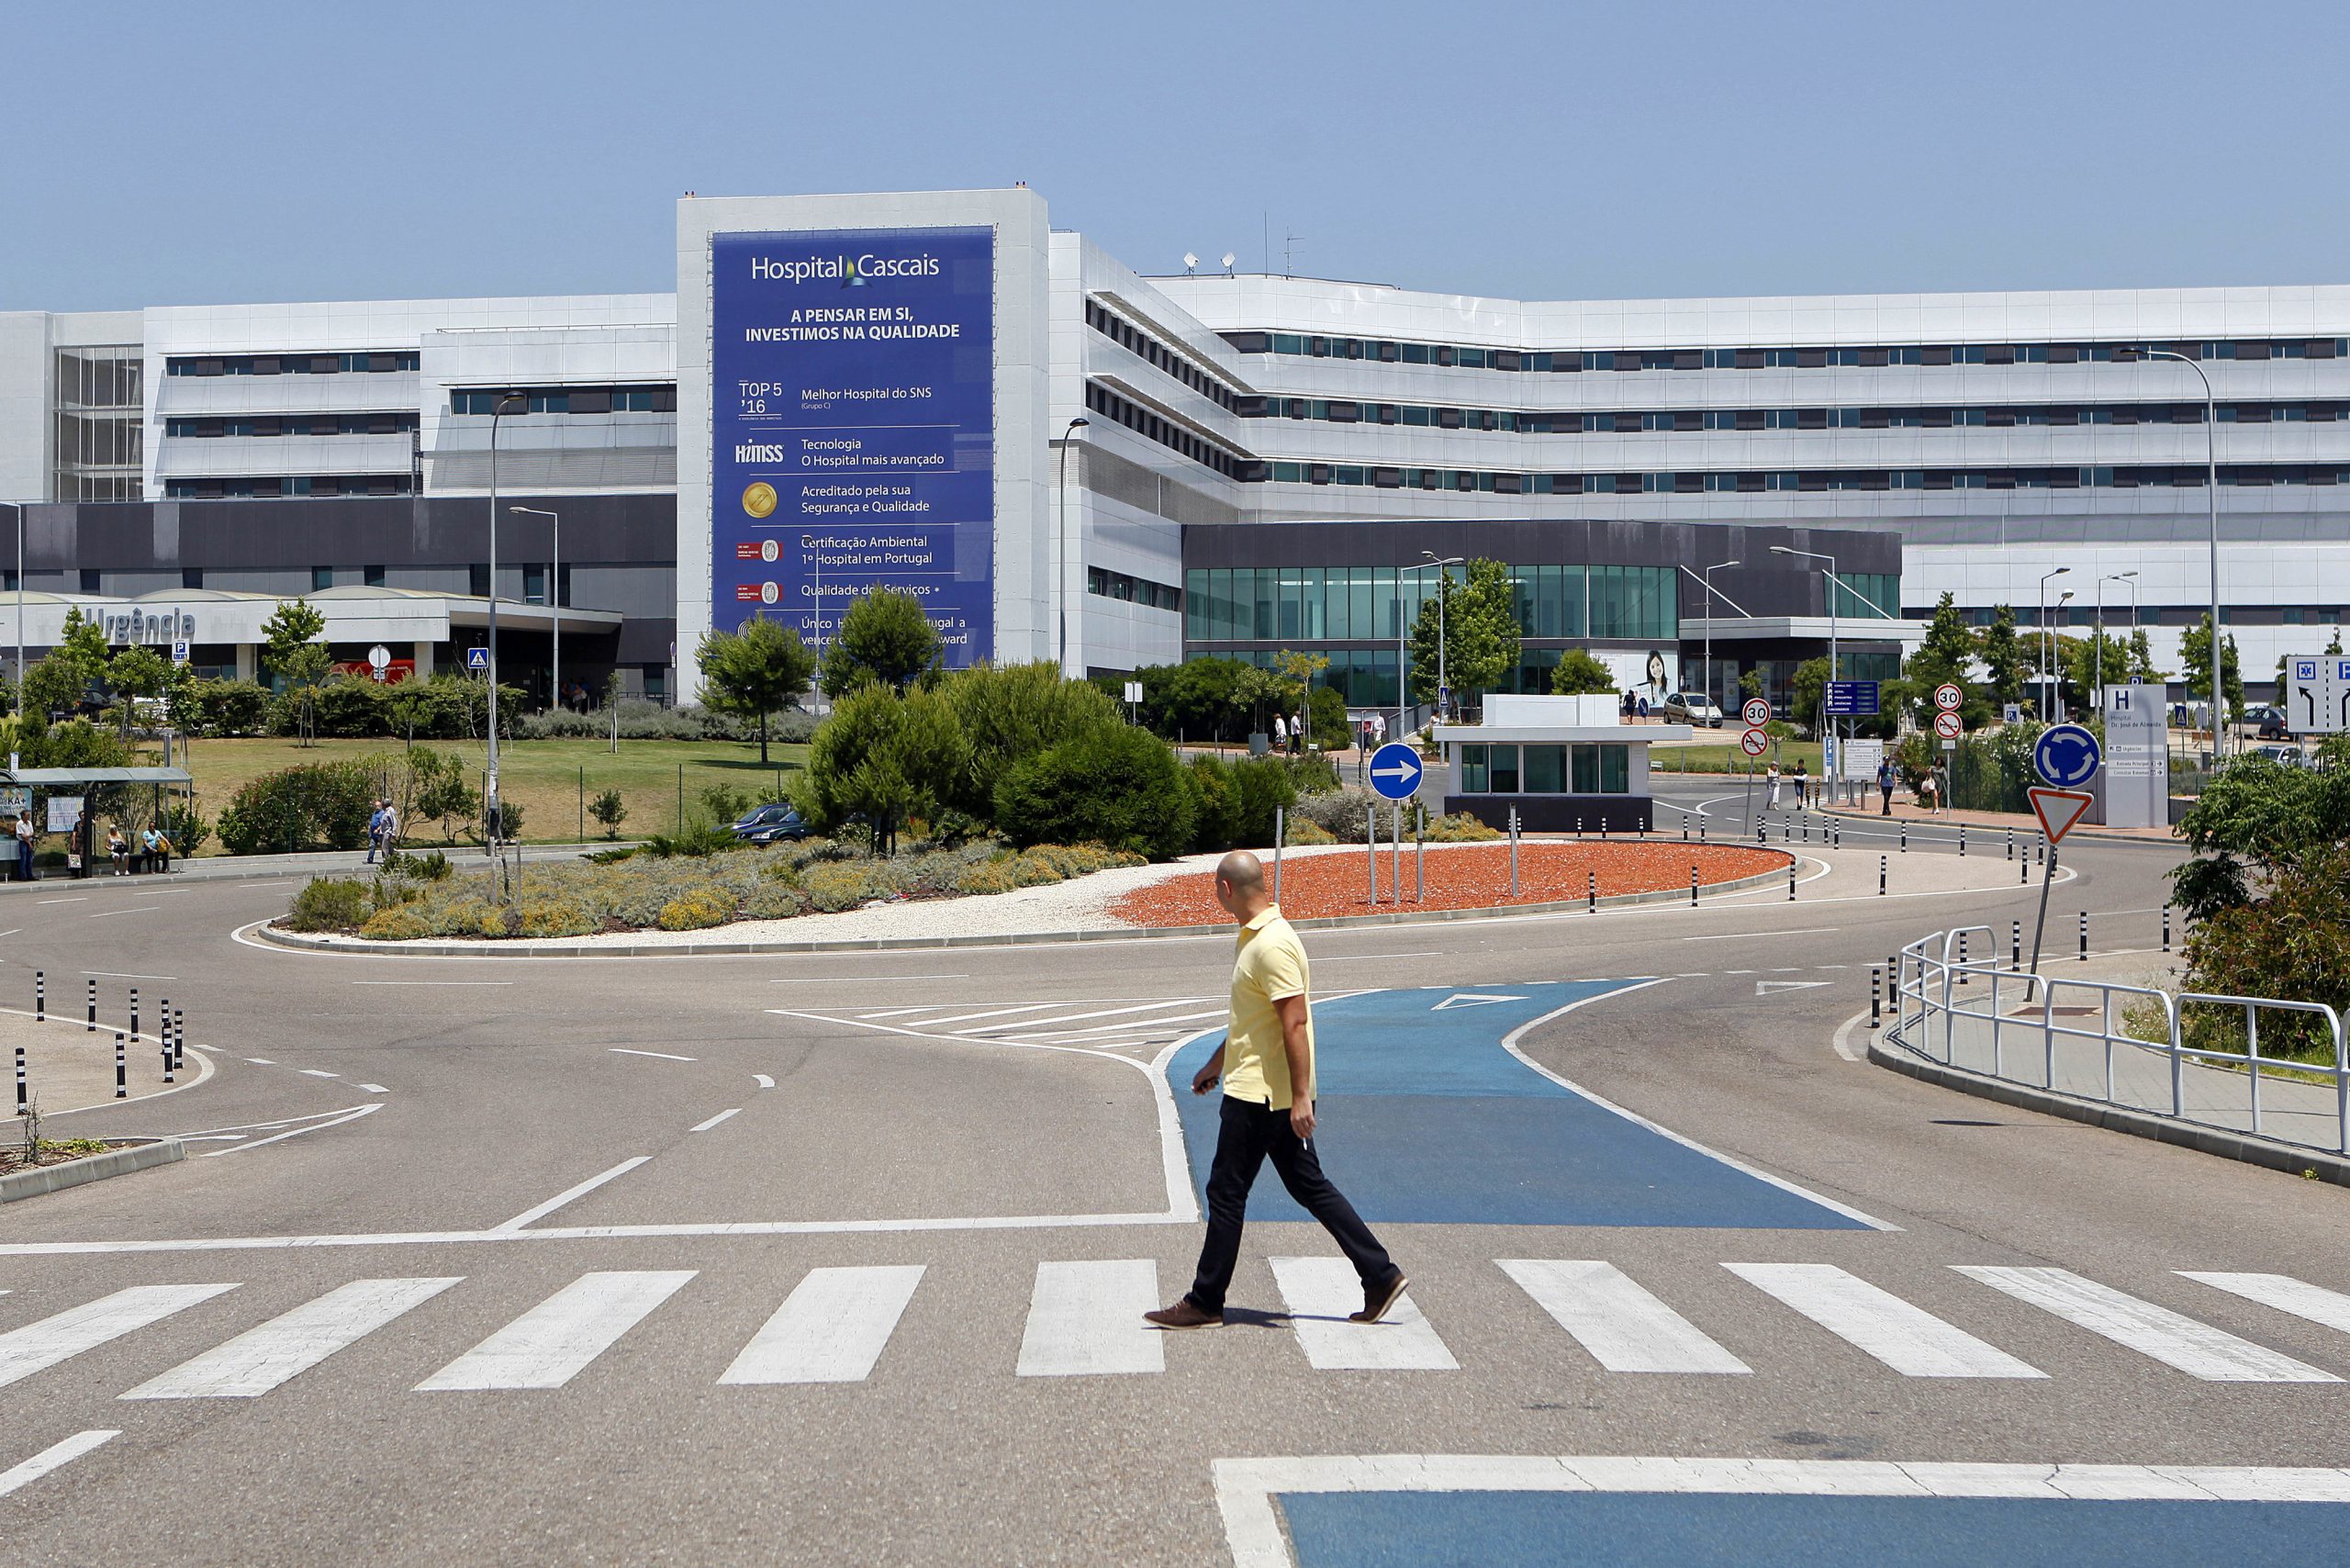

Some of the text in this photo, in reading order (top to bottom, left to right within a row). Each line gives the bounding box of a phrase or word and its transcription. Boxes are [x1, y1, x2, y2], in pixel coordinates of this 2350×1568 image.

[752, 253, 940, 285] Hospital Cascais
[790, 308, 914, 323] A PENSAR EM SI,
[745, 324, 960, 342] INVESTIMOS NA QUALIDADE
[738, 382, 782, 398] TOP 5
[801, 386, 932, 401] Melhor Hospital do SNS
[801, 402, 822, 410] (Grupo
[801, 438, 862, 452] Tecnologia
[801, 453, 945, 467] O Hospital mais avançado
[801, 484, 911, 498] Acreditado pela sua
[801, 500, 930, 515] Segurança e Qualidade
[801, 535, 927, 550] Certificação Ambiental
[815, 553, 861, 567] Hospital
[864, 555, 882, 565] em
[885, 553, 933, 566] Portugal
[801, 584, 859, 597] Qualidade
[884, 584, 931, 597] Serviços
[958, 619, 966, 628] a
[176, 643, 185, 653] P
[1939, 692, 1958, 703] 30
[2115, 690, 2129, 710] H
[1748, 708, 1766, 719] 30
